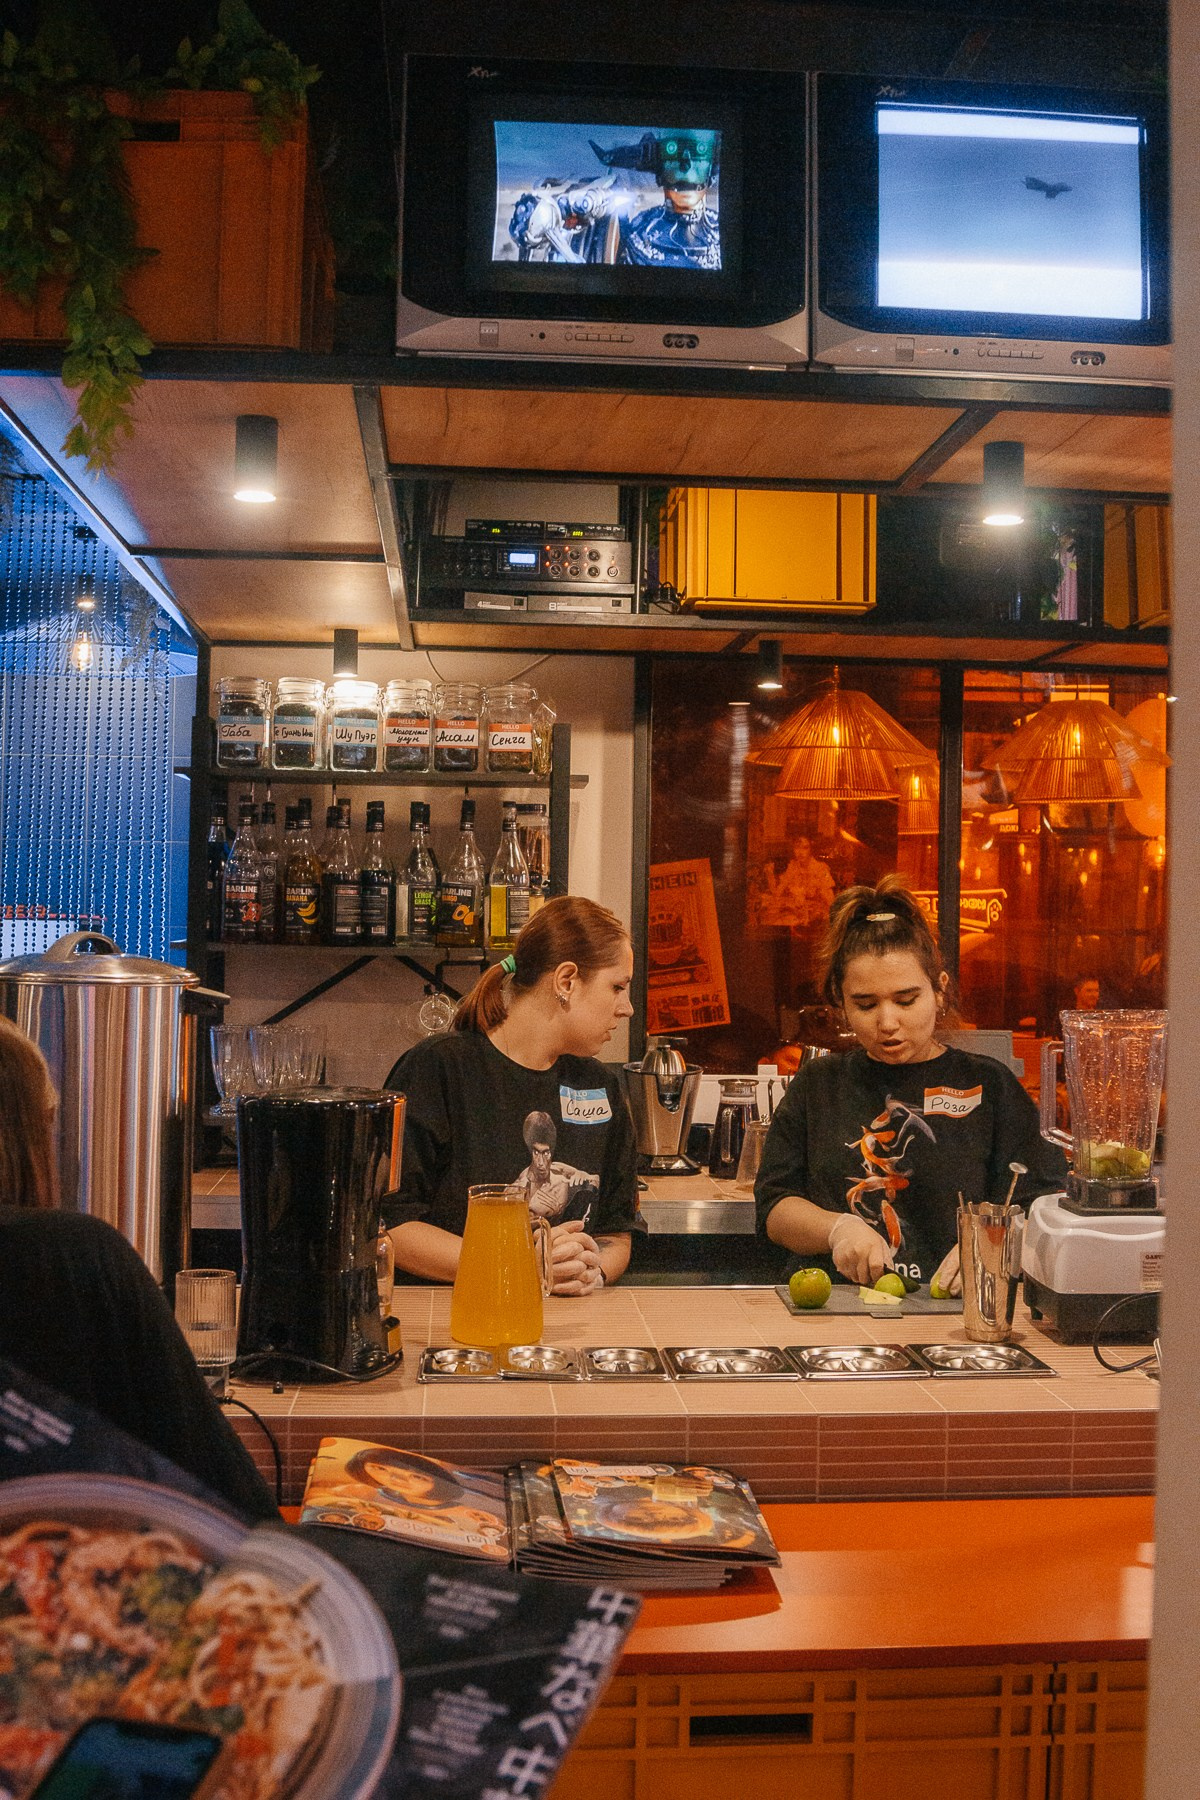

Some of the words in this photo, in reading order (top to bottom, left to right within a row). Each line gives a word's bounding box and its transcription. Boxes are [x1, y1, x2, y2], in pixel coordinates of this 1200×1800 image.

[335, 728, 353, 743] Шу
[354, 729, 376, 743] Пуэр
[435, 732, 475, 743] Ассам
[226, 884, 258, 894] BARLINE
[941, 1087, 964, 1096] HELLO
[566, 1099, 608, 1118] Саша
[931, 1096, 971, 1113] Роза
